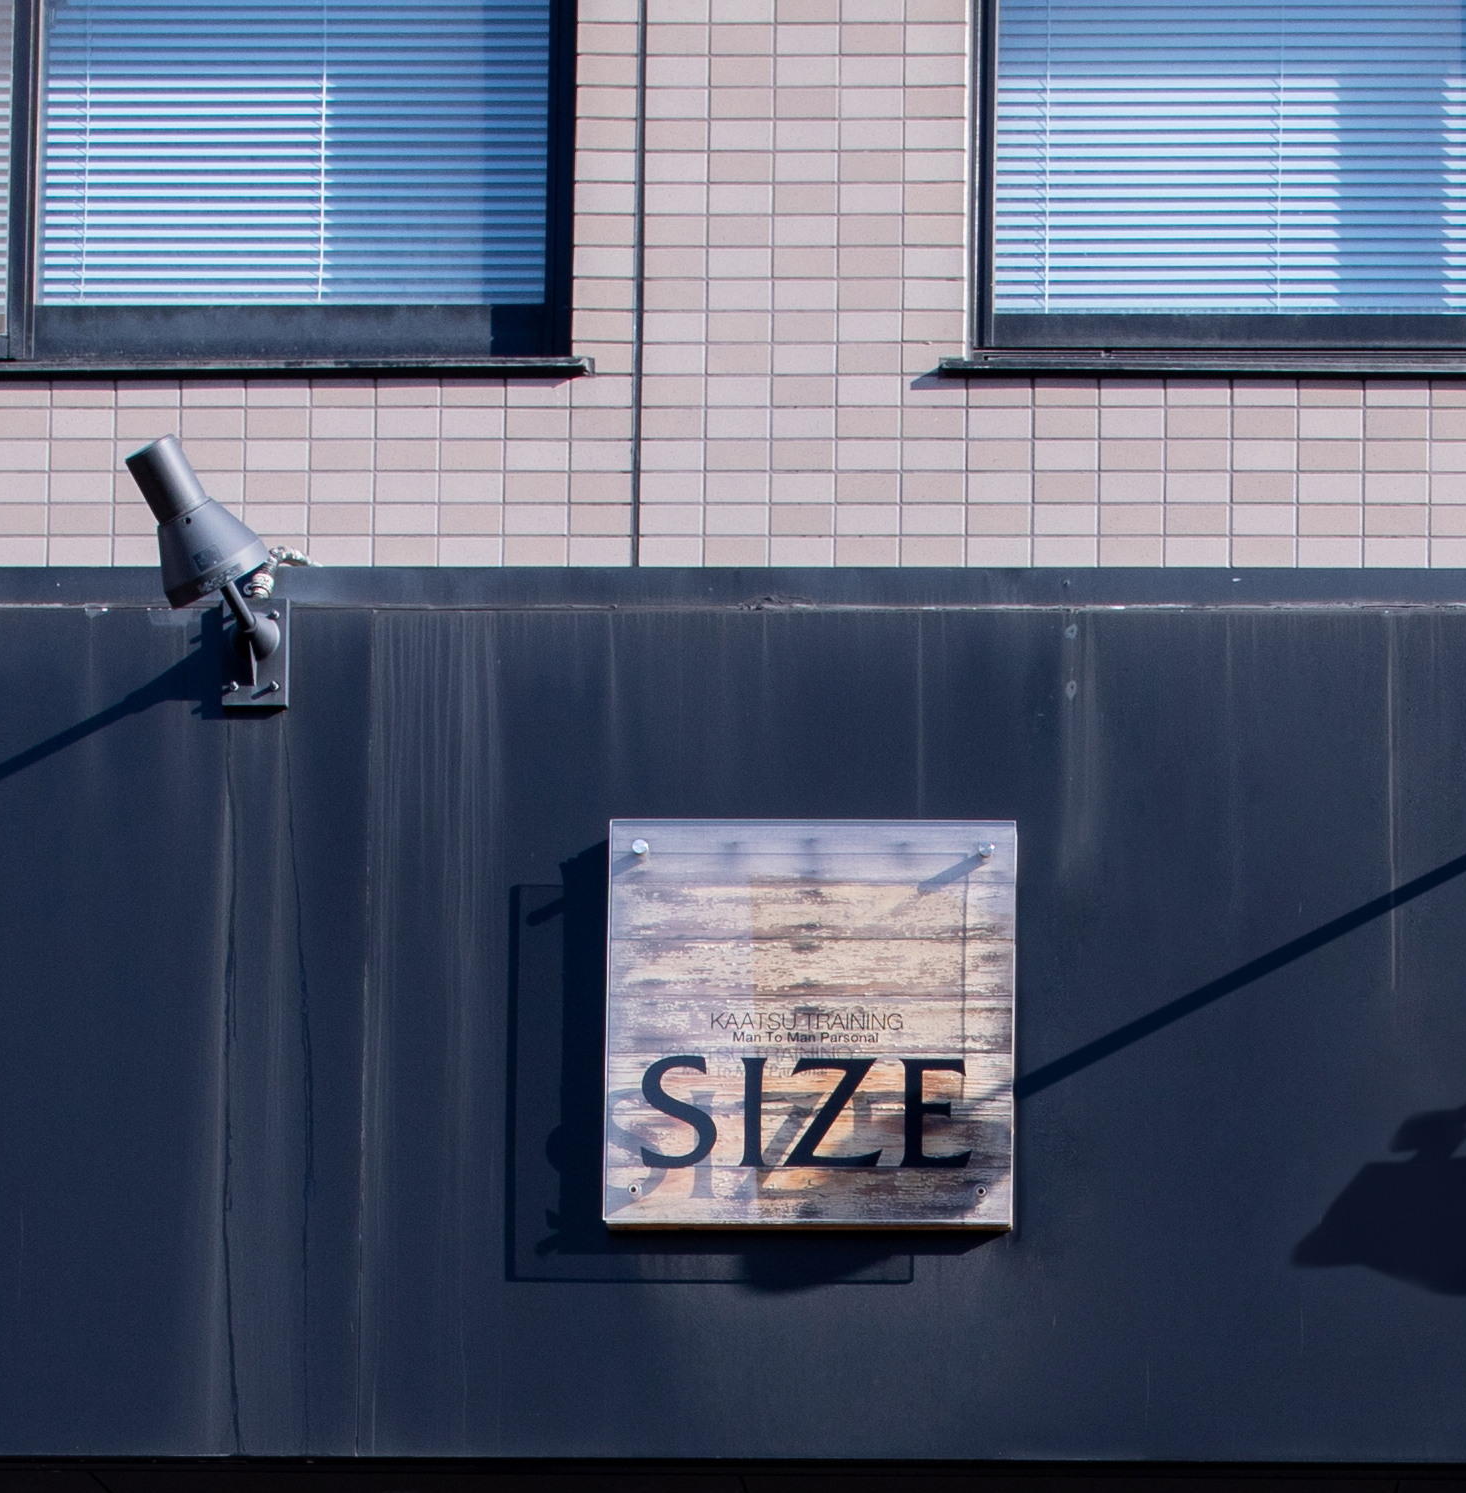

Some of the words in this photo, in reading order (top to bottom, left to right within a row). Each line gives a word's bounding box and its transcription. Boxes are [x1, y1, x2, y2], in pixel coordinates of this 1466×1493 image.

[710, 1012, 797, 1031] KAATSU
[802, 1012, 904, 1031] TRAINING
[732, 1031, 763, 1044] Man
[766, 1031, 784, 1044] To
[787, 1031, 817, 1044] Man
[820, 1031, 880, 1044] Parsonal
[639, 1054, 974, 1169] SIZE
